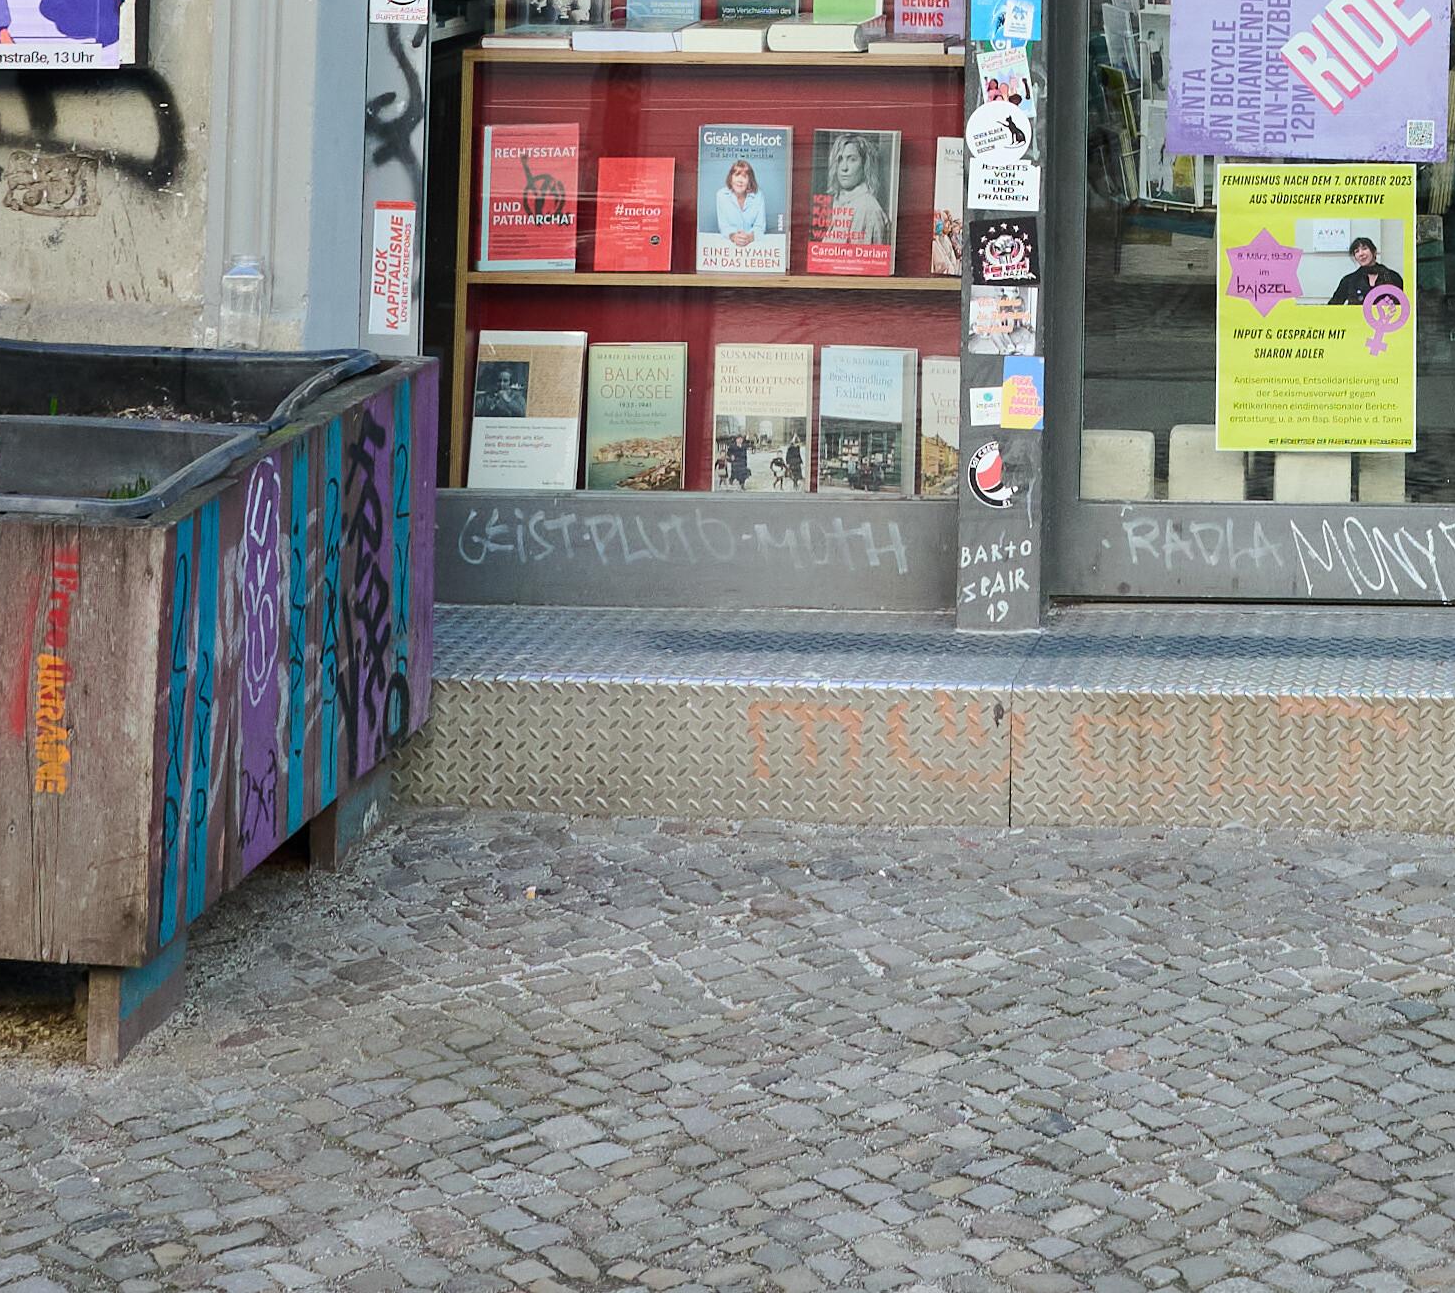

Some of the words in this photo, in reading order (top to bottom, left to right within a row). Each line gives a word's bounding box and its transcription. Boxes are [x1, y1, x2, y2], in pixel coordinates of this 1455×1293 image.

[902, 12, 944, 27] PUNKS
[53, 51, 69, 64] 13
[72, 51, 95, 64] Uhr
[703, 131, 738, 147] Gisèle
[741, 132, 782, 147] Pelicot
[494, 146, 577, 158] RECHTSSTAAT
[1222, 175, 1281, 187] FEMINISMUS
[1283, 175, 1309, 187] NACH
[1312, 175, 1332, 187] DEM
[1334, 175, 1341, 187] 7.
[1345, 175, 1387, 187] OKTOBER
[1390, 175, 1412, 187] 2023
[493, 202, 521, 213] UND
[493, 213, 575, 226] PATRIARCHAT
[703, 247, 729, 258] EINE
[735, 247, 781, 258] HYMNE
[703, 258, 718, 268] AN
[720, 258, 741, 268] DAS
[744, 258, 781, 268] LEBEN
[374, 248, 388, 296] FUCK
[386, 215, 403, 329] KAPITALISME
